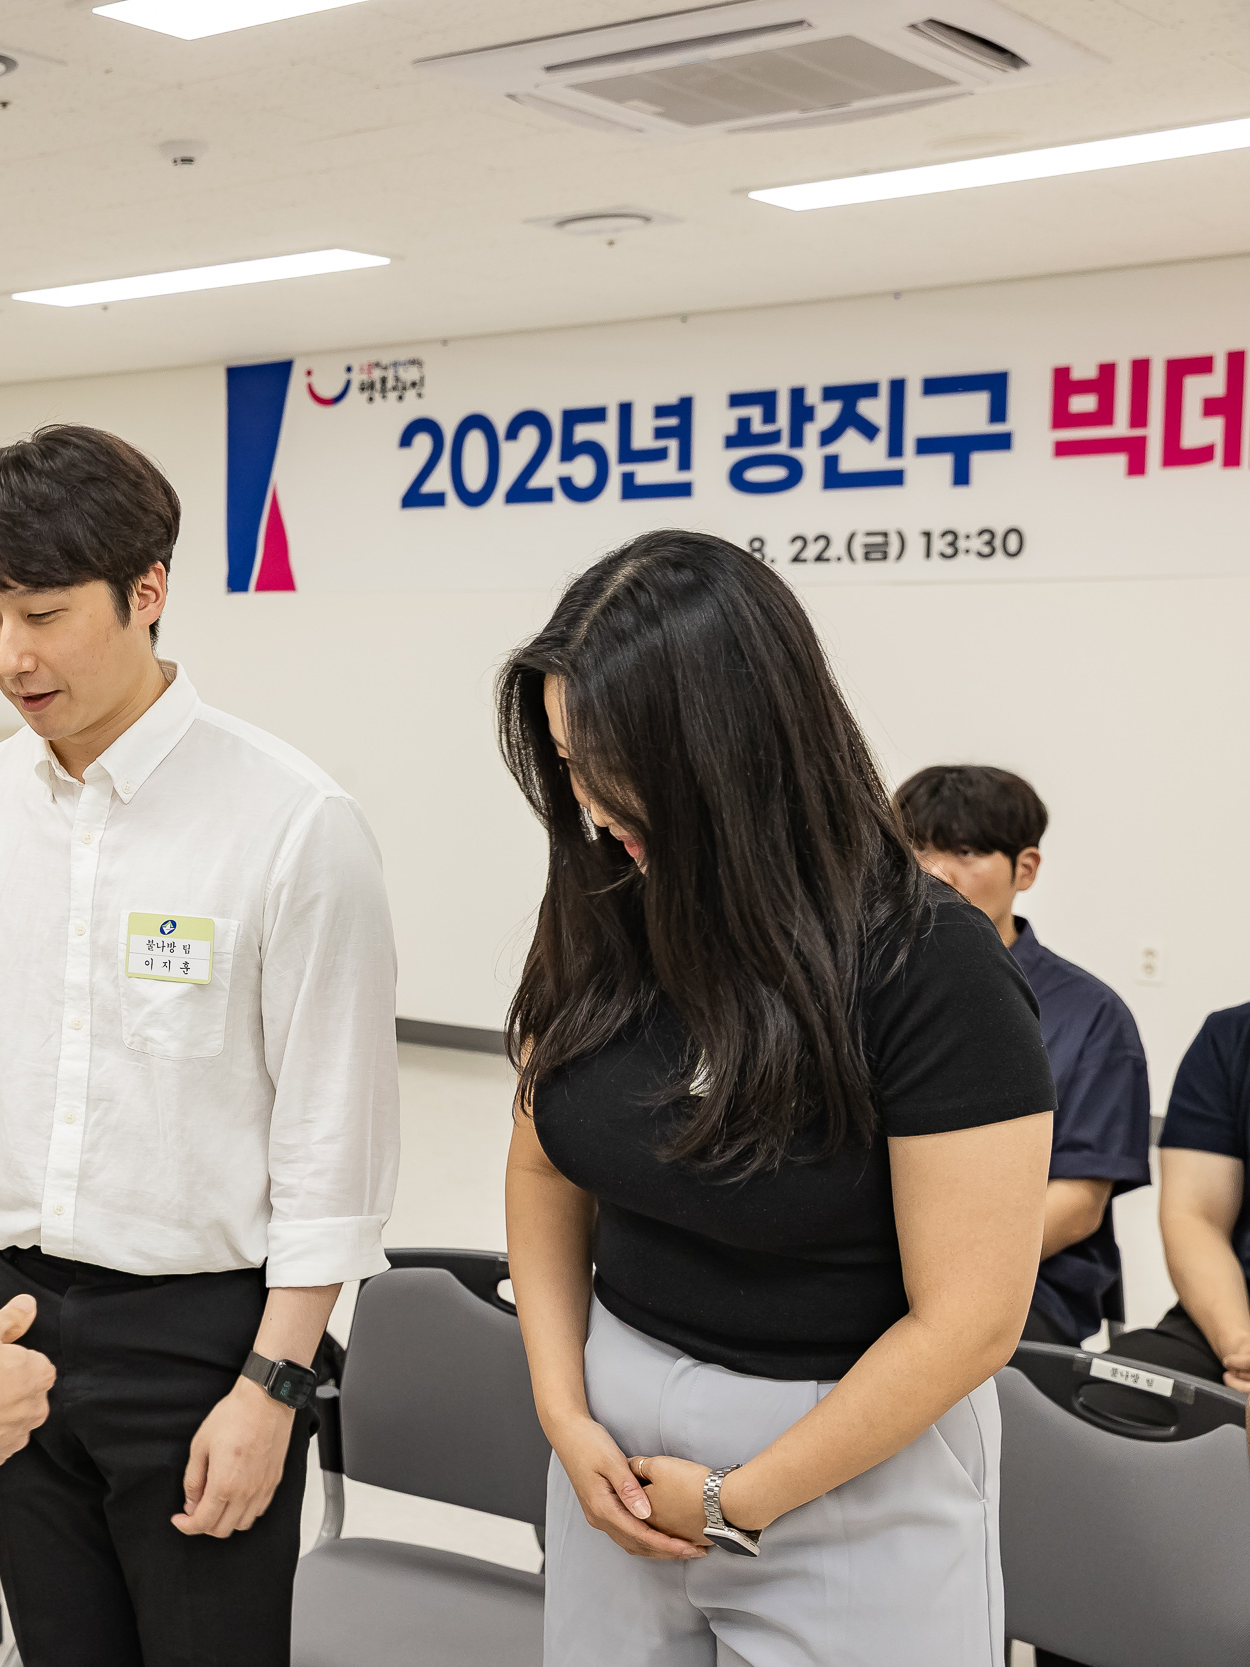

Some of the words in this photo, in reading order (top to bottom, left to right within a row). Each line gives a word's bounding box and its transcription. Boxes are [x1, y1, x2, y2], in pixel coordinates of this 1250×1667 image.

[398, 395, 694, 509] 2025년
[723, 370, 1013, 495] 광진구
[921, 527, 1024, 560] 13:30
[182, 943, 191, 955] 팀
